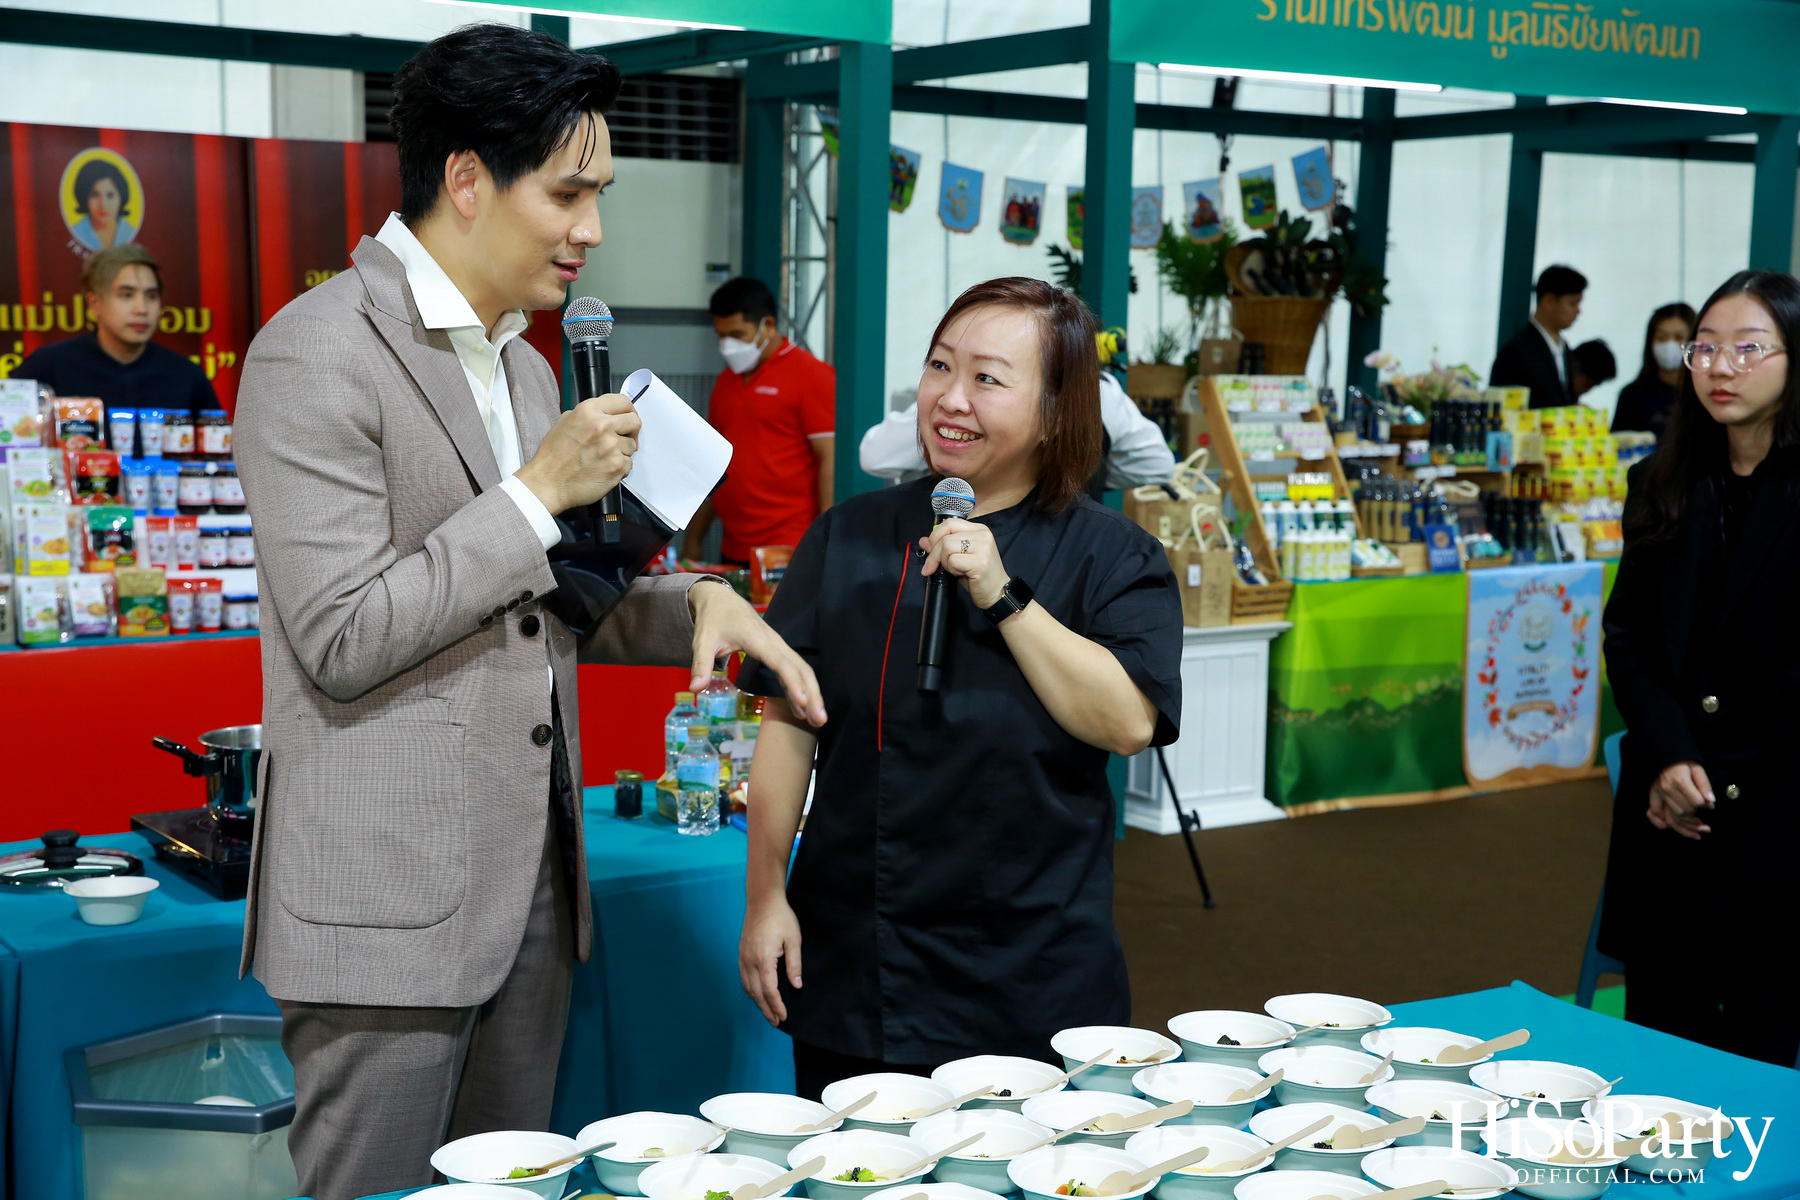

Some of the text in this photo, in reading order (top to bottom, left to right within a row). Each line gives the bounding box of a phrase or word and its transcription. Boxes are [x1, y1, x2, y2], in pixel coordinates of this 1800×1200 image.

[1488, 2, 1700, 59] มูลนิธิชัยพัฒนา
